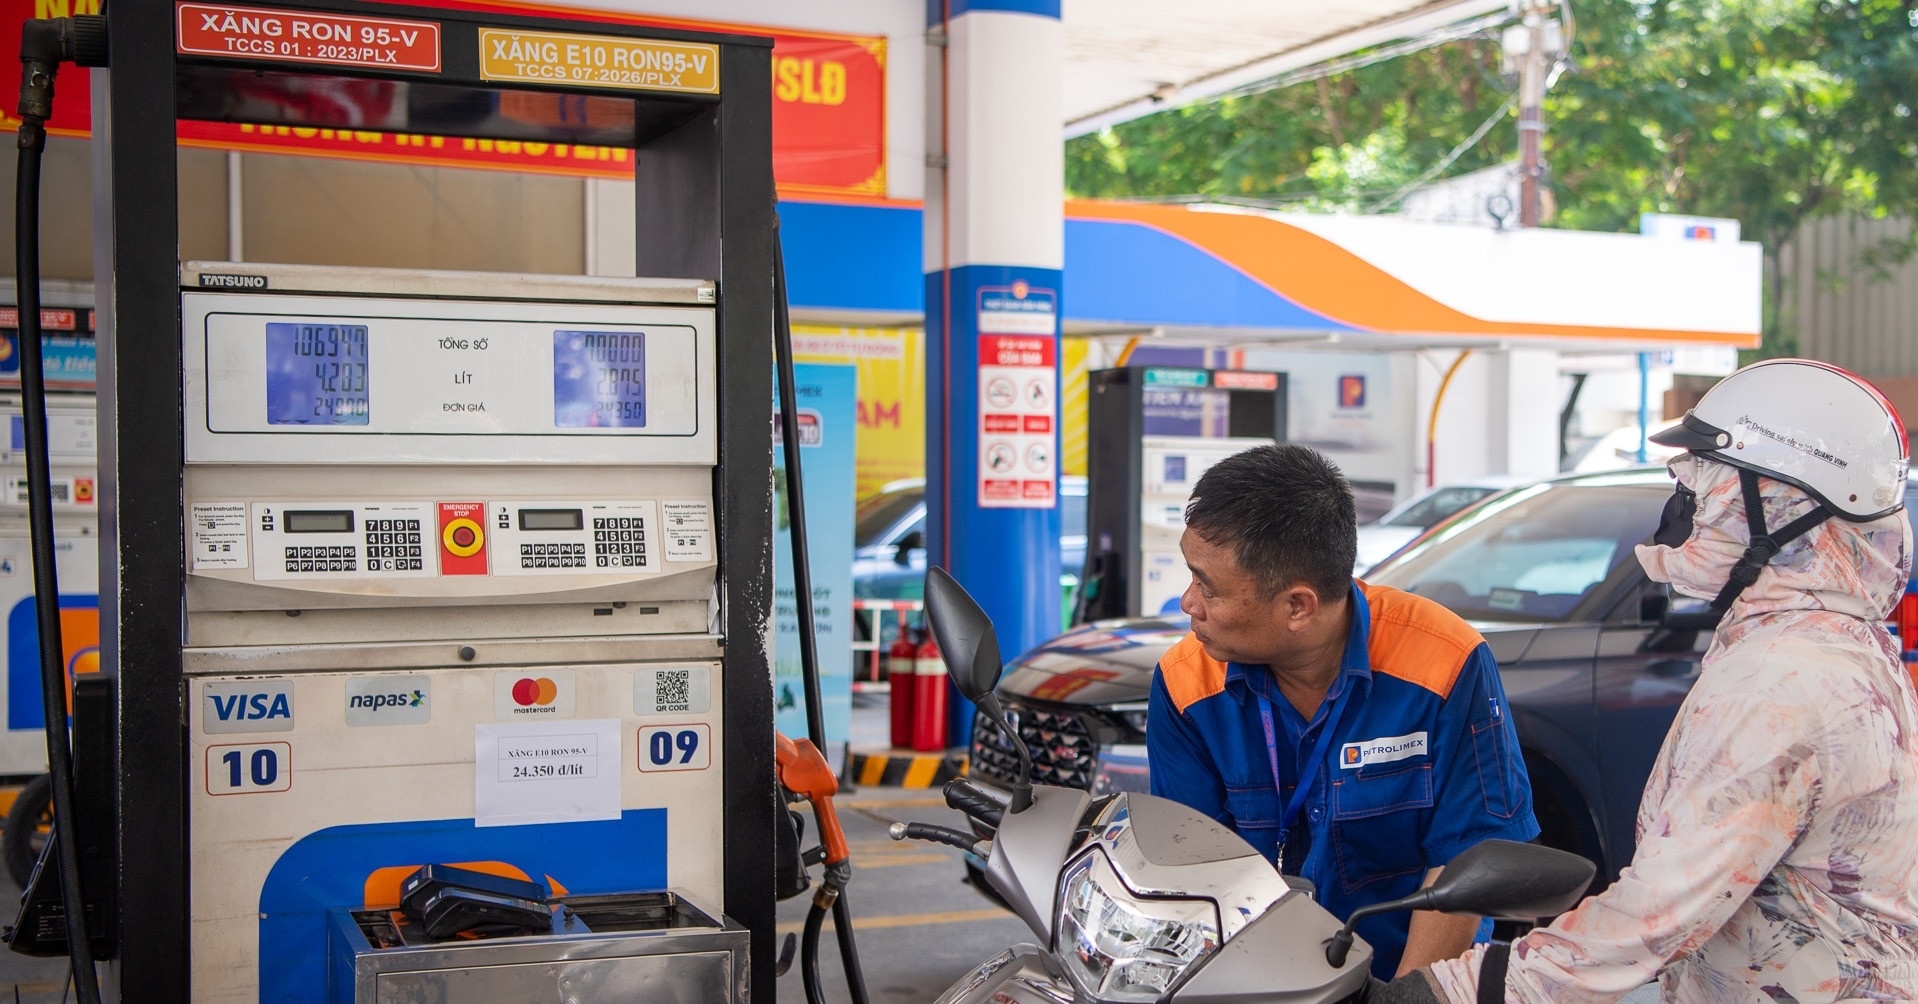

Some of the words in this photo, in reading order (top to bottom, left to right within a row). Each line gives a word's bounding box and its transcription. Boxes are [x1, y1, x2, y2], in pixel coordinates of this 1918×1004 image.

[201, 11, 283, 36] XĂNG
[292, 21, 351, 42] RON
[361, 27, 418, 47] 95-V
[225, 37, 275, 53] TCCS
[281, 41, 300, 55] 01
[318, 45, 397, 62] 2023/PLX
[492, 35, 558, 63] XĂNG
[567, 44, 606, 66] E10
[614, 48, 707, 74] RON95-V
[515, 63, 566, 78] TCCS
[771, 56, 847, 106] SLĐ
[203, 275, 264, 288] TATSUNO
[295, 327, 366, 357] 106947
[438, 336, 469, 349] TỔNG
[473, 337, 488, 350] SỐ
[455, 371, 472, 384] LÍT
[443, 403, 465, 412] ĐƠN
[467, 402, 485, 412] GIÁ
[1751, 422, 1775, 439] Driving
[1814, 448, 1834, 462] QUANG
[1834, 457, 1848, 468] VINH
[369, 521, 375, 530] 7
[383, 521, 389, 530] 8
[397, 521, 403, 530] 9
[596, 519, 602, 528] 7
[609, 519, 616, 528] 8
[622, 519, 628, 528] 9
[370, 534, 376, 543] 4
[383, 534, 390, 544] 5
[397, 534, 404, 544] 6
[597, 532, 604, 541] 4
[610, 532, 617, 541] 5
[623, 532, 629, 541] 6
[286, 549, 297, 557] P1
[301, 549, 312, 557] P2
[315, 548, 326, 557] P3
[329, 548, 341, 556] P4
[343, 548, 355, 556] P5
[370, 547, 376, 557] 1
[384, 547, 390, 557] 2
[398, 547, 405, 556] 3
[561, 545, 571, 553] P4
[598, 544, 603, 554] 1
[610, 544, 618, 553] 2
[623, 544, 630, 553] 3
[287, 562, 298, 570] P6
[301, 562, 313, 570] P7
[316, 562, 327, 570] P8
[330, 562, 341, 570] P9
[370, 560, 377, 570] 0
[384, 560, 392, 570] C
[522, 559, 533, 567] P6
[562, 558, 572, 566] P9
[575, 558, 586, 566] P10
[598, 557, 606, 566] 0
[611, 557, 619, 566] C
[208, 693, 290, 721] VISA
[350, 694, 407, 711] napas
[513, 706, 556, 714] mastercard
[508, 749, 533, 758] XĂNG
[535, 749, 549, 757] E10
[551, 748, 569, 756] RON
[571, 747, 588, 755] 95-V
[650, 730, 699, 765] 09
[223, 749, 277, 787] 10
[513, 765, 554, 778] 24.350
[558, 763, 584, 776] đ/lít
